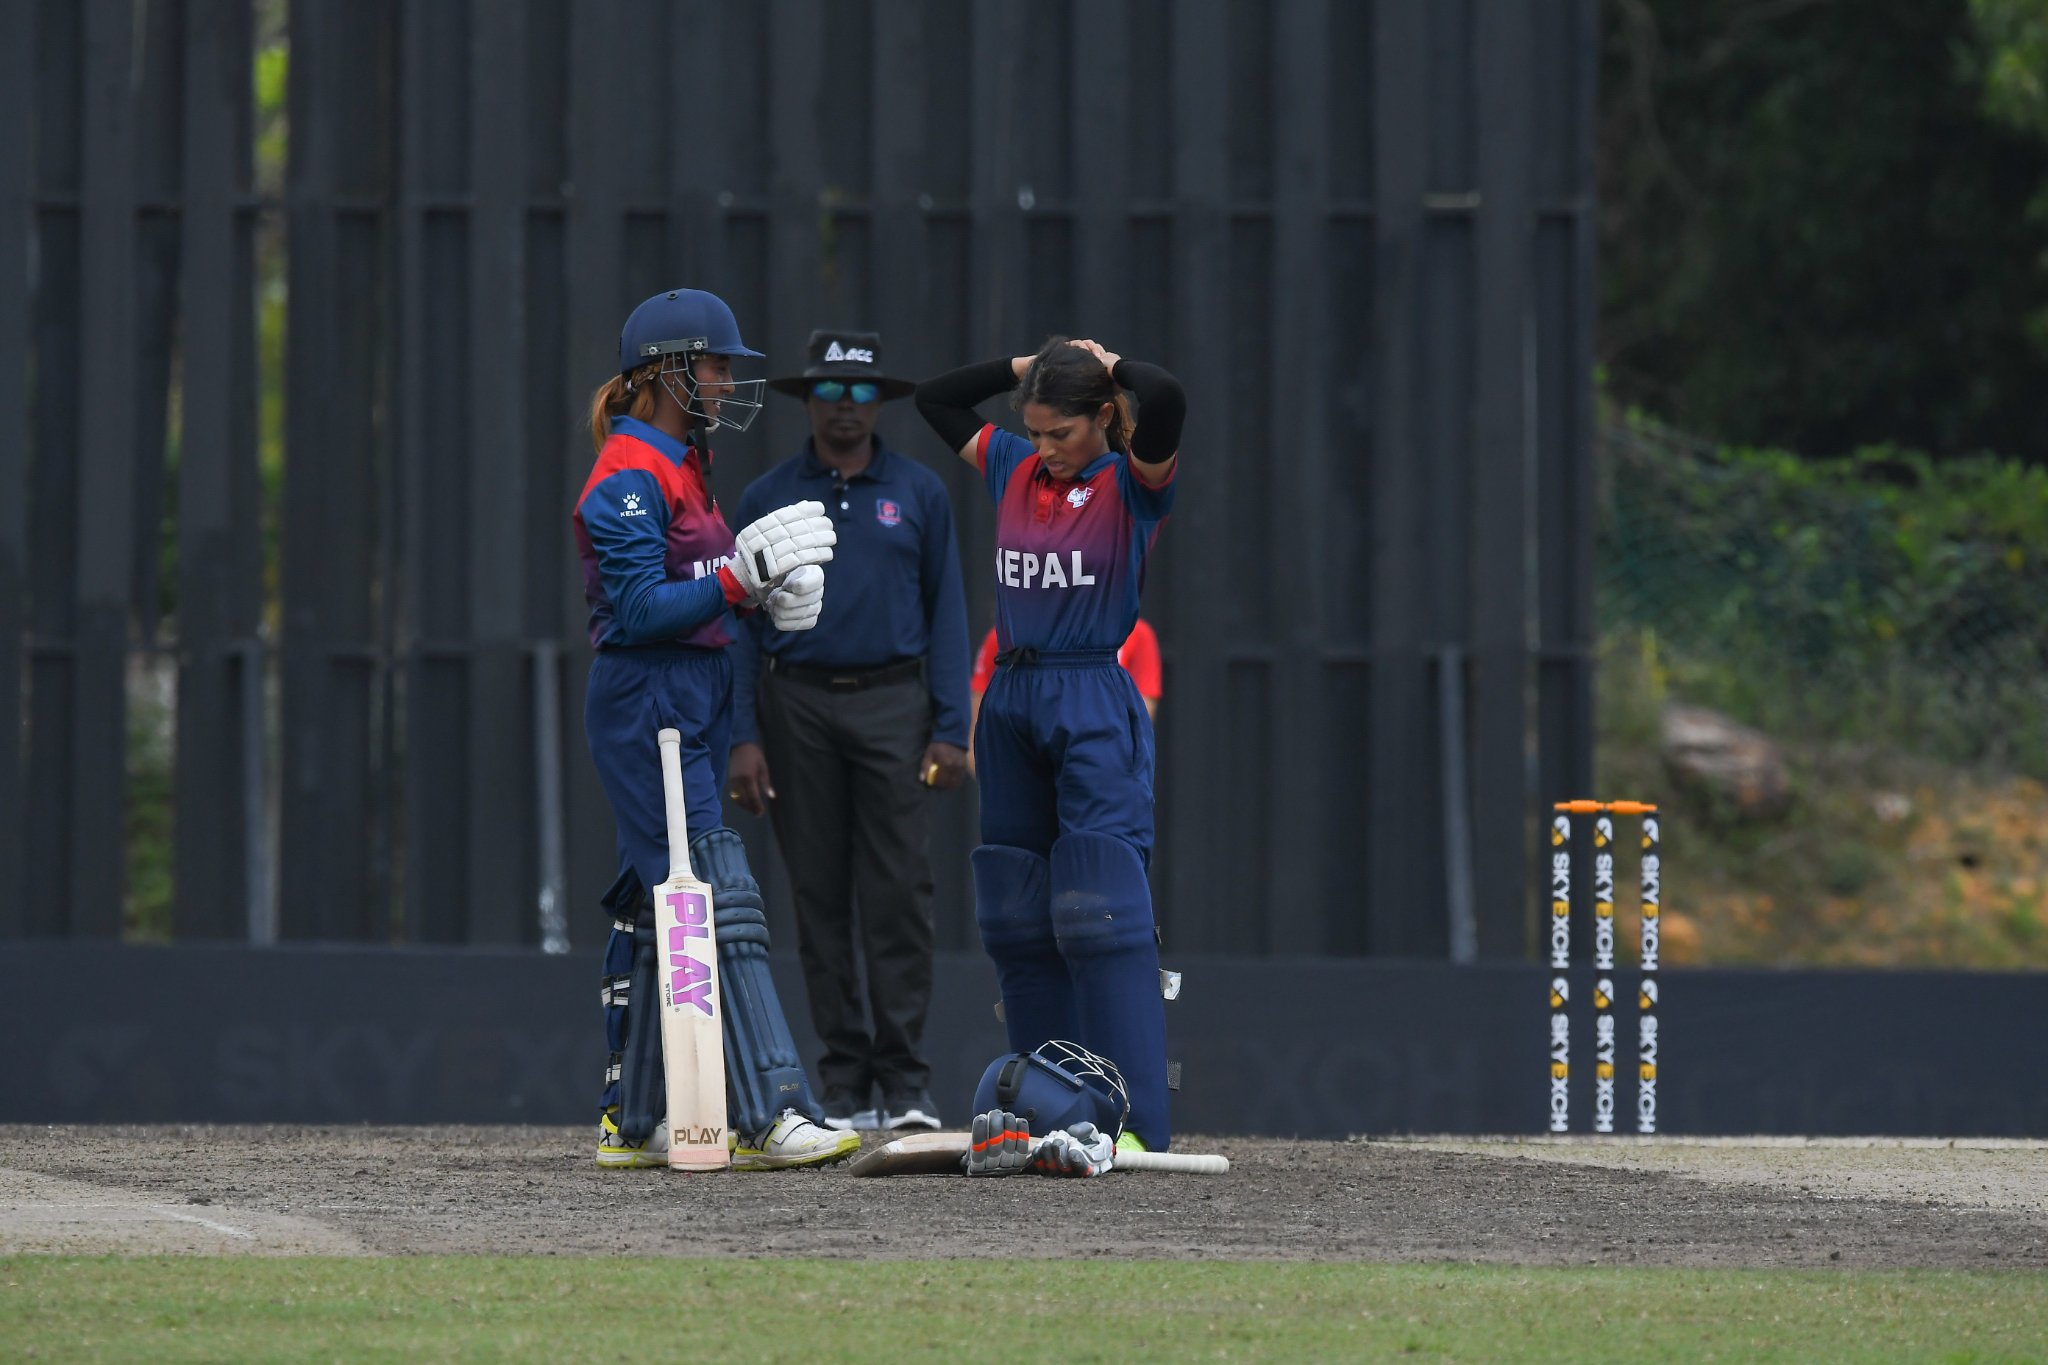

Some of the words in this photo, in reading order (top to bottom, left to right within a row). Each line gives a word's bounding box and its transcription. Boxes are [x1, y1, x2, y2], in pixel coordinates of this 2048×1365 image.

[620, 509, 647, 518] KELME
[996, 547, 1095, 589] NEPAL
[666, 892, 713, 1016] PLAY
[1552, 852, 1570, 969] SKYEXCH
[1595, 853, 1614, 970] SKYEXCH
[1641, 854, 1660, 971] SKYEXCH
[1550, 1013, 1569, 1132] SKYEXCH
[1596, 1014, 1615, 1133] SKYEXCH
[1638, 1015, 1658, 1133] SKYEXCH
[674, 1127, 722, 1145] PLAY
